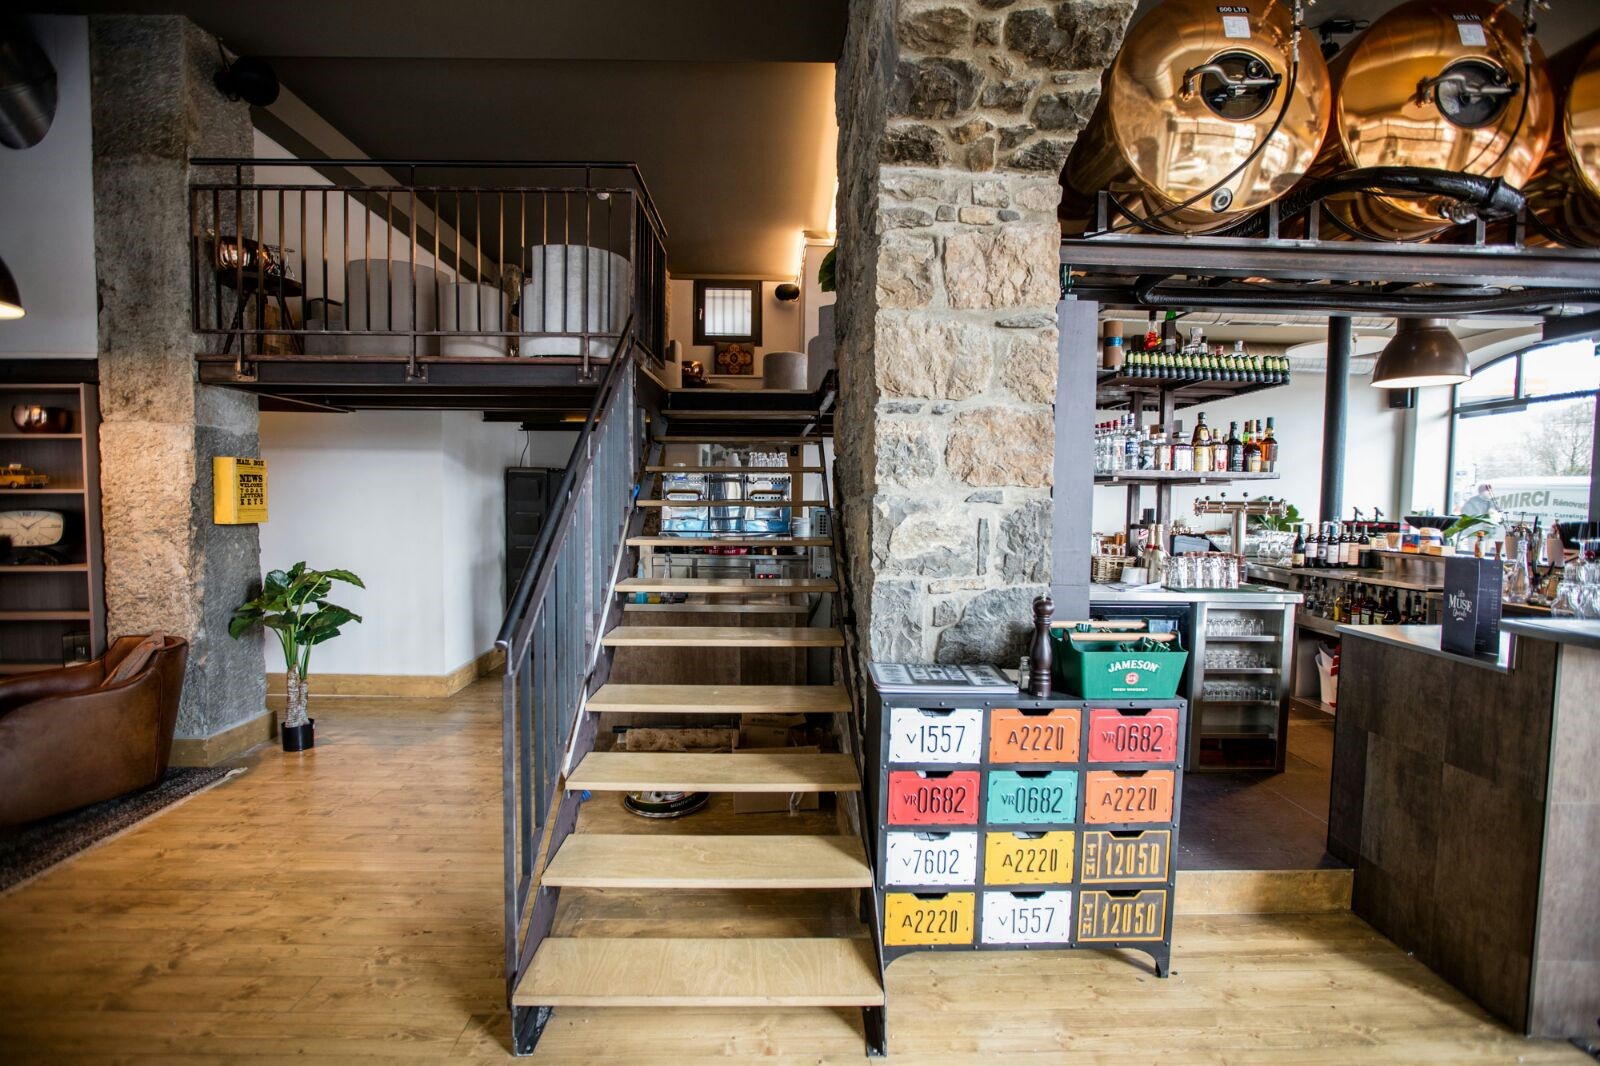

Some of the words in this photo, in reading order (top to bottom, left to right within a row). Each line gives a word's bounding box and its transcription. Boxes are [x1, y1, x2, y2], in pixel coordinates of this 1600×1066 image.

[240, 474, 263, 482] NEWS
[1448, 594, 1472, 613] MUSE
[1108, 660, 1159, 672] JAMESON
[1105, 842, 1160, 875] 12050
[1102, 902, 1156, 934] 12050
